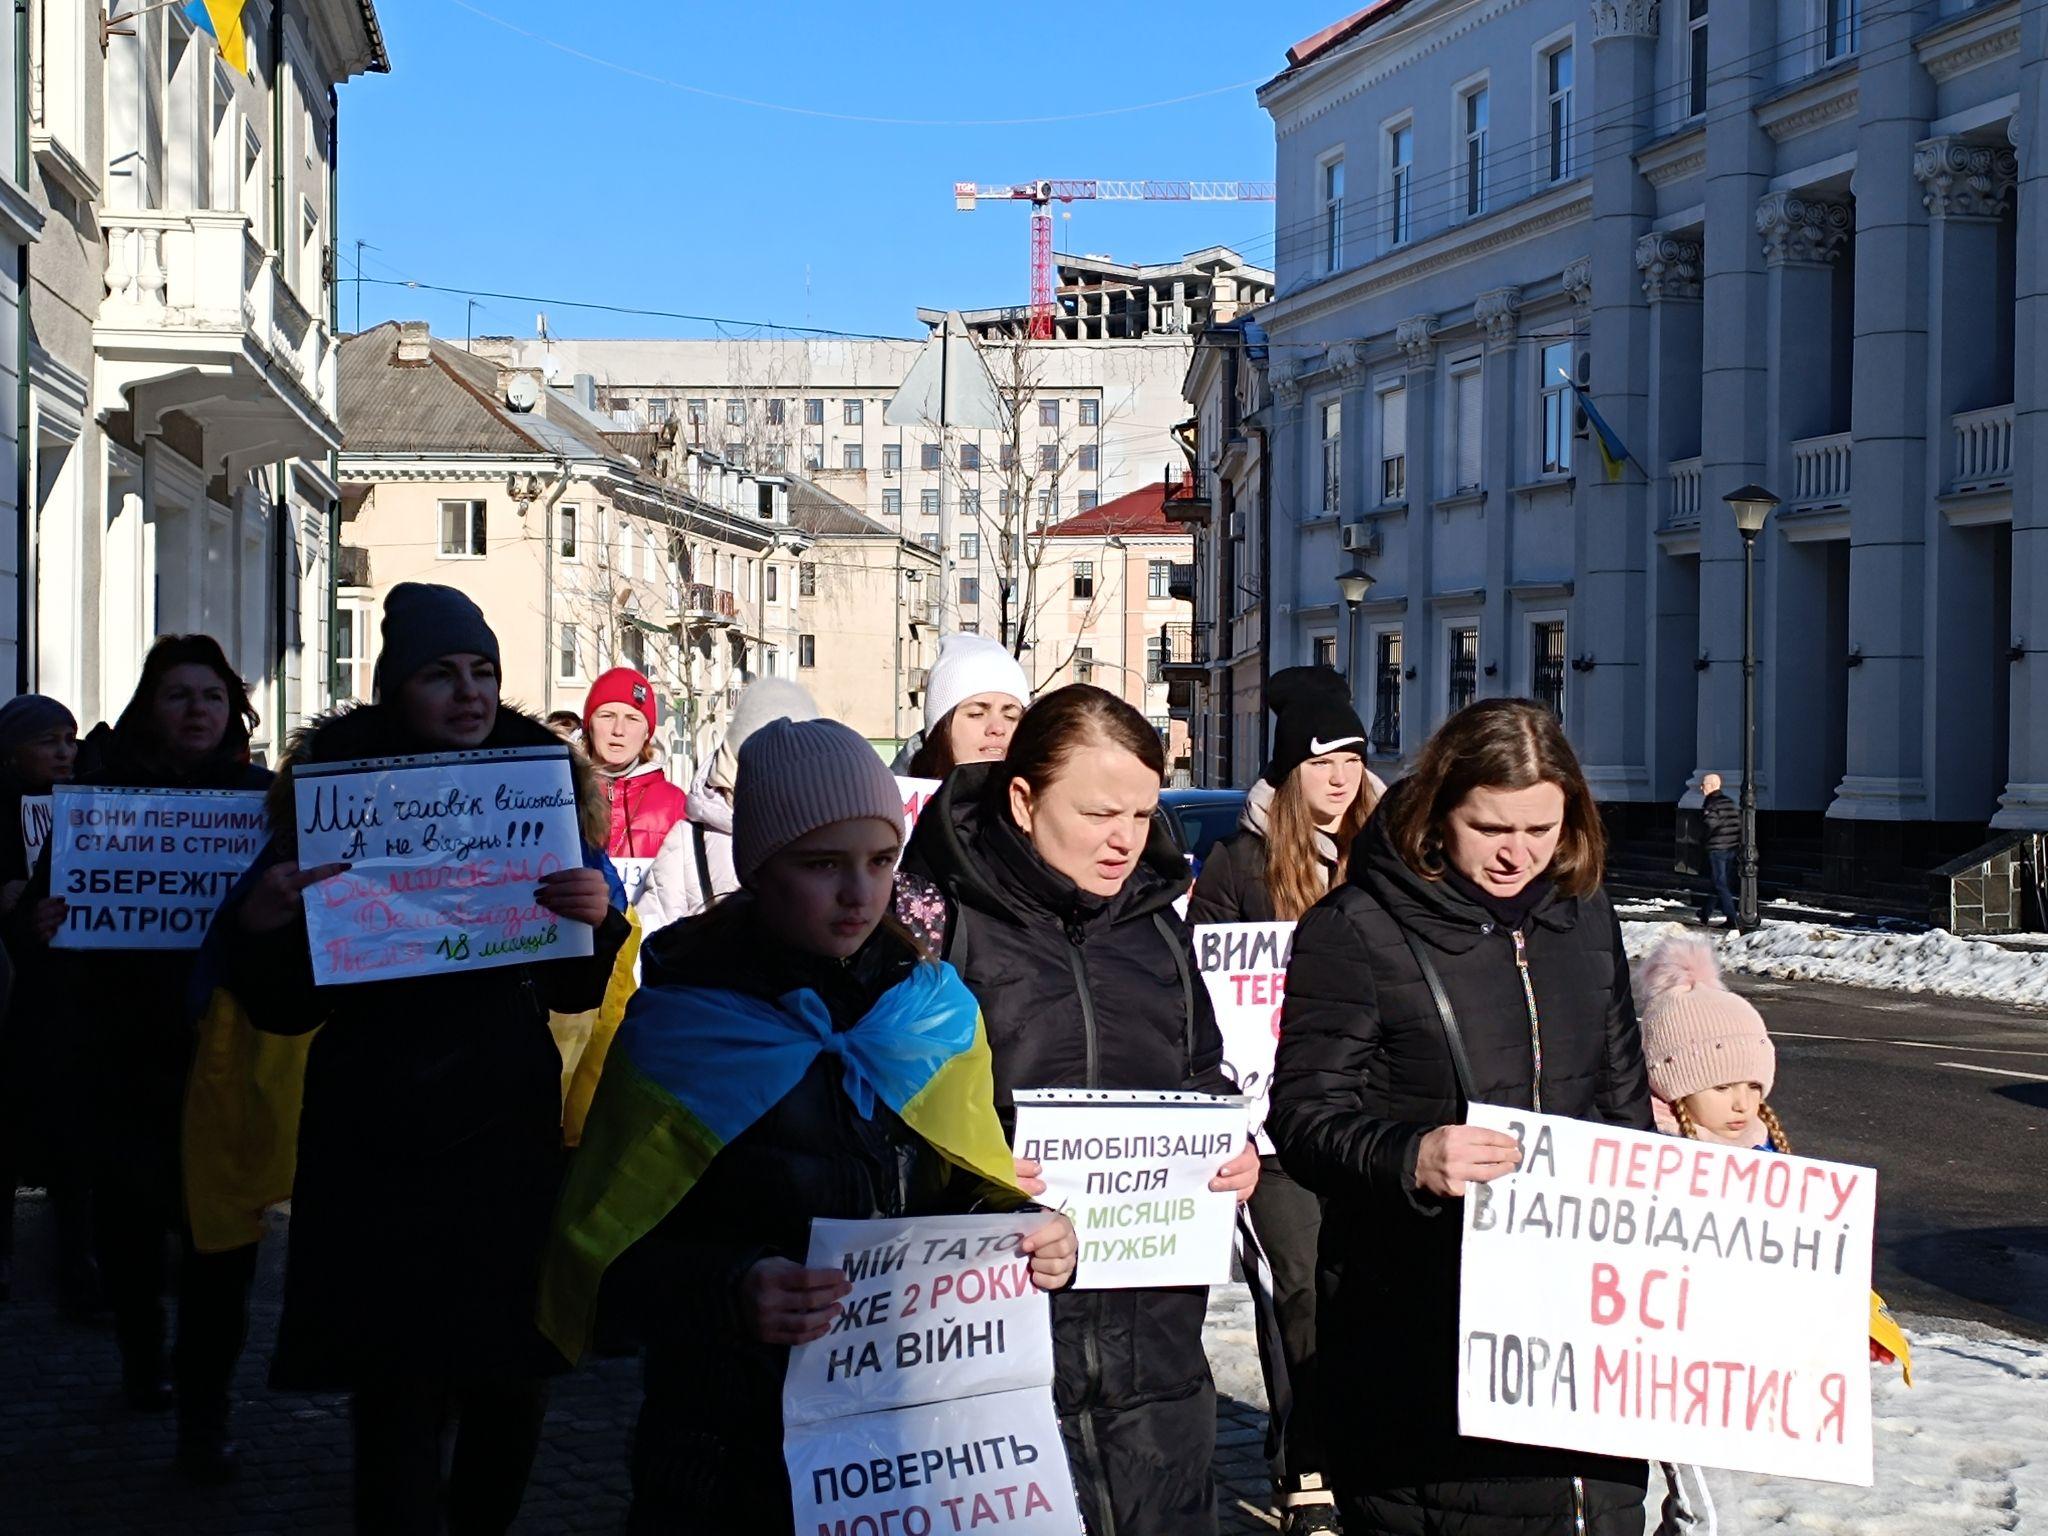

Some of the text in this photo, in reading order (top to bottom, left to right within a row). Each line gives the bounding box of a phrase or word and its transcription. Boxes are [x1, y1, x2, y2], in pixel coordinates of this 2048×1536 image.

[70, 809, 264, 831] ВОНИ ПЕРШИМИ
[304, 785, 383, 834] Мій
[394, 788, 484, 821] чоловік
[75, 834, 256, 855] СТАЛИ В СТРІЙ!
[386, 839, 413, 857] не
[67, 869, 242, 897] ЗБЕРЕЖІТ
[70, 905, 215, 933] ПАТРІОТ
[436, 932, 471, 961] 18
[1230, 973, 1286, 1006] ТЕР
[1024, 1133, 1232, 1164] ДЕМОБІЛІЗАЦІЯ
[1086, 1168, 1169, 1195] ПІСЛЯ
[1508, 1120, 1859, 1222] ЗА ПЕРЕМОГУ
[1087, 1198, 1195, 1230] МІСЯЦІВ
[1472, 1179, 1851, 1275] ВІДПОВІДАЛЬНІ
[841, 1232, 1025, 1284] МІЙ ТАТО
[1080, 1233, 1177, 1263] ЛУЖБИ
[829, 1263, 1039, 1336] ЖЕ 2 РОКИ
[1590, 1262, 1690, 1331] ВСІ
[826, 1316, 1006, 1383] НА ВІЙНІ
[1466, 1330, 1847, 1445] ПОРА МІНЯТИСЯ
[812, 1434, 1039, 1505] ПОВЕРНІТЬ
[940, 1481, 1054, 1534] ТАТА
